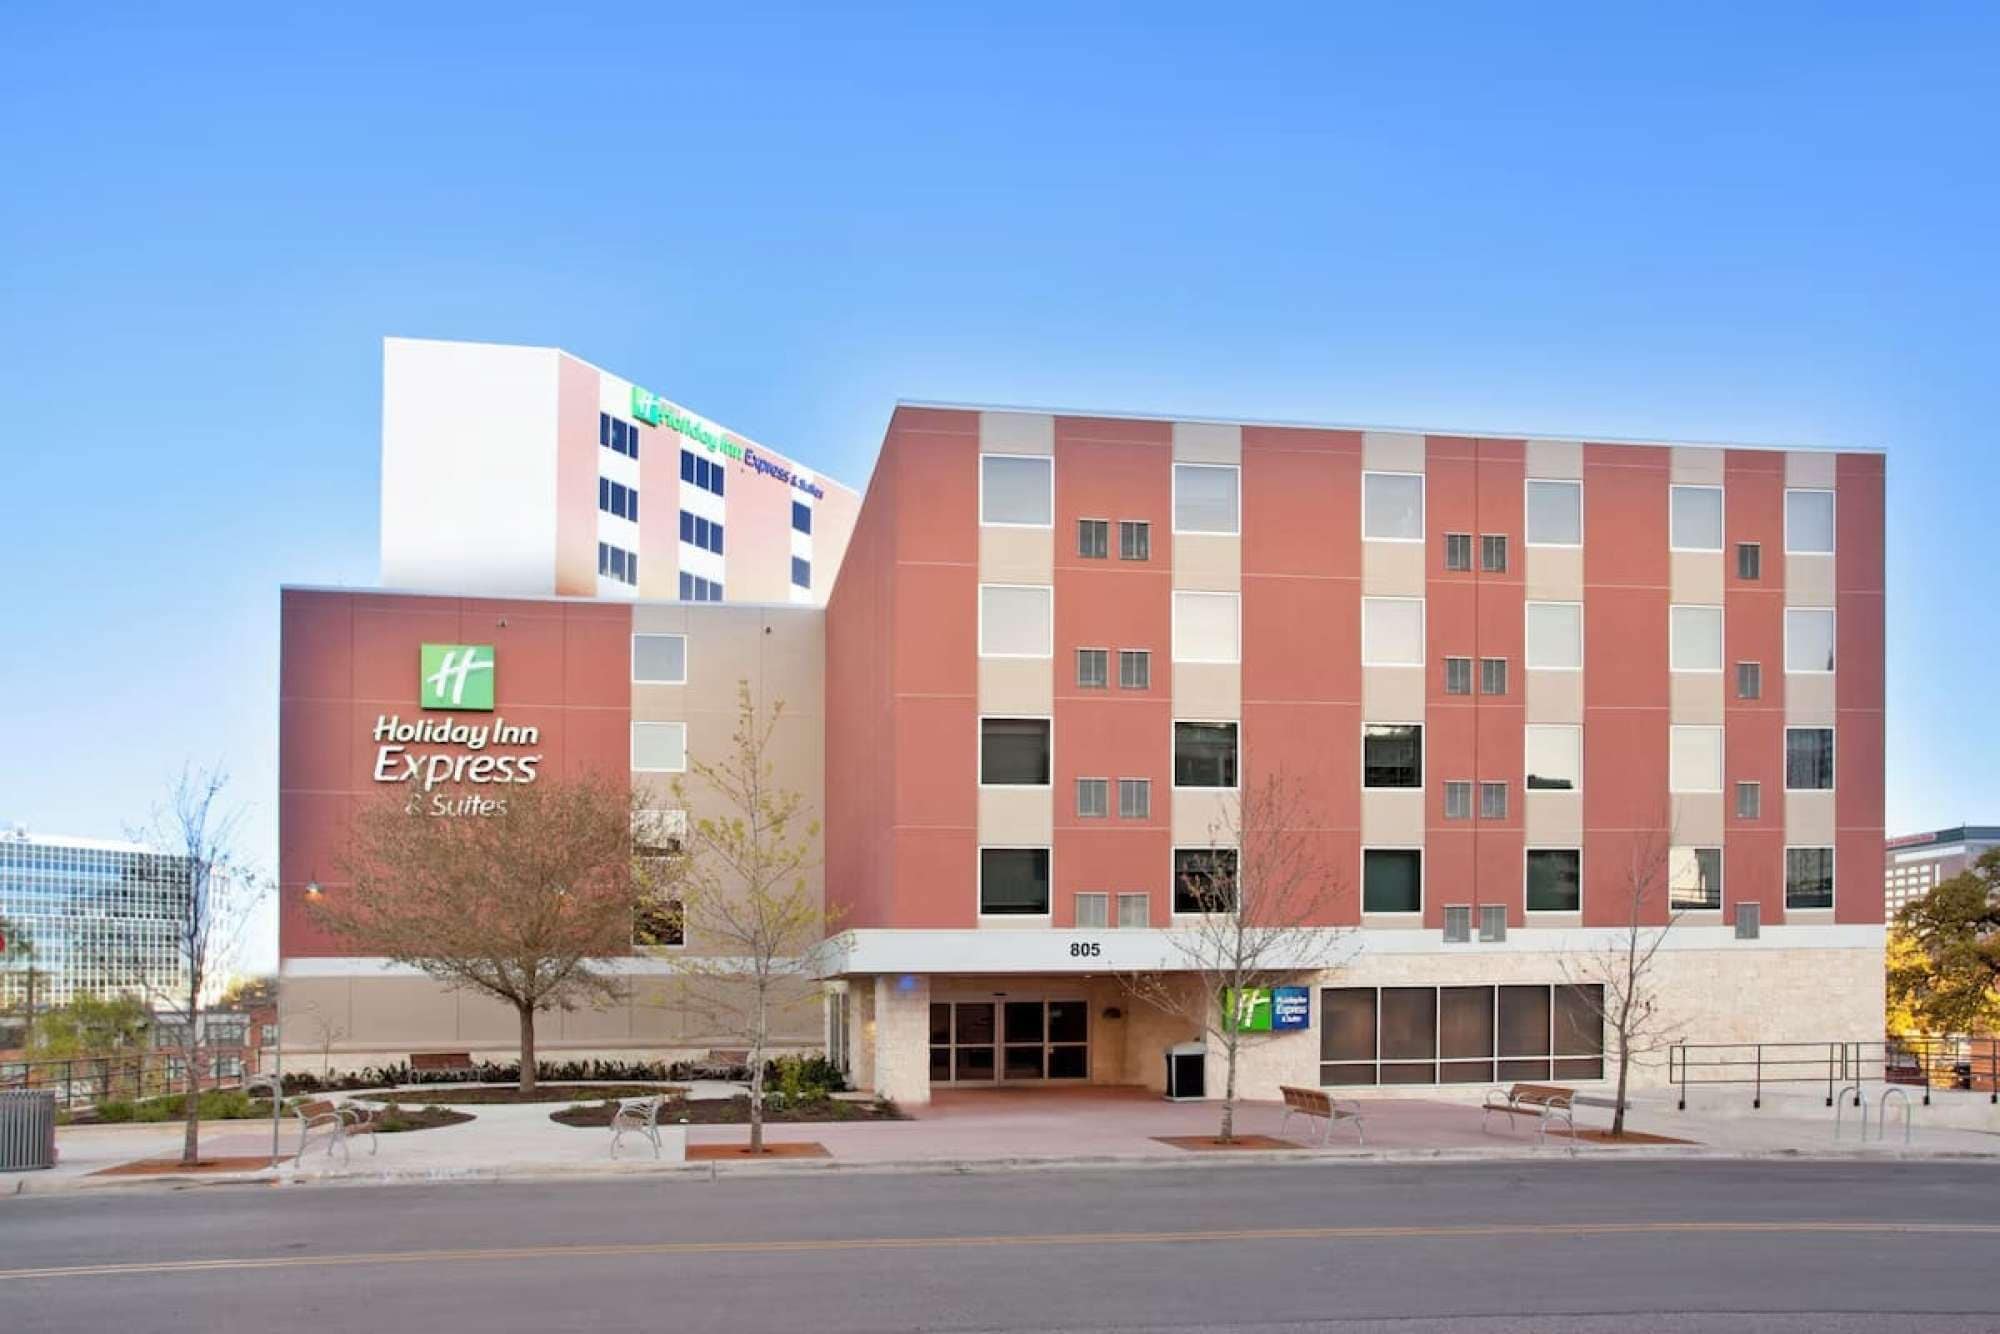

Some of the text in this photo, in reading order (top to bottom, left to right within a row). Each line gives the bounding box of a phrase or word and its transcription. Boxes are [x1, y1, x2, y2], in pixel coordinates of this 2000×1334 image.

[744, 447, 790, 483] Express
[373, 714, 539, 751] Holiday Inn
[373, 745, 539, 793] Express
[430, 793, 508, 818] Suites
[1070, 943, 1100, 957] 805
